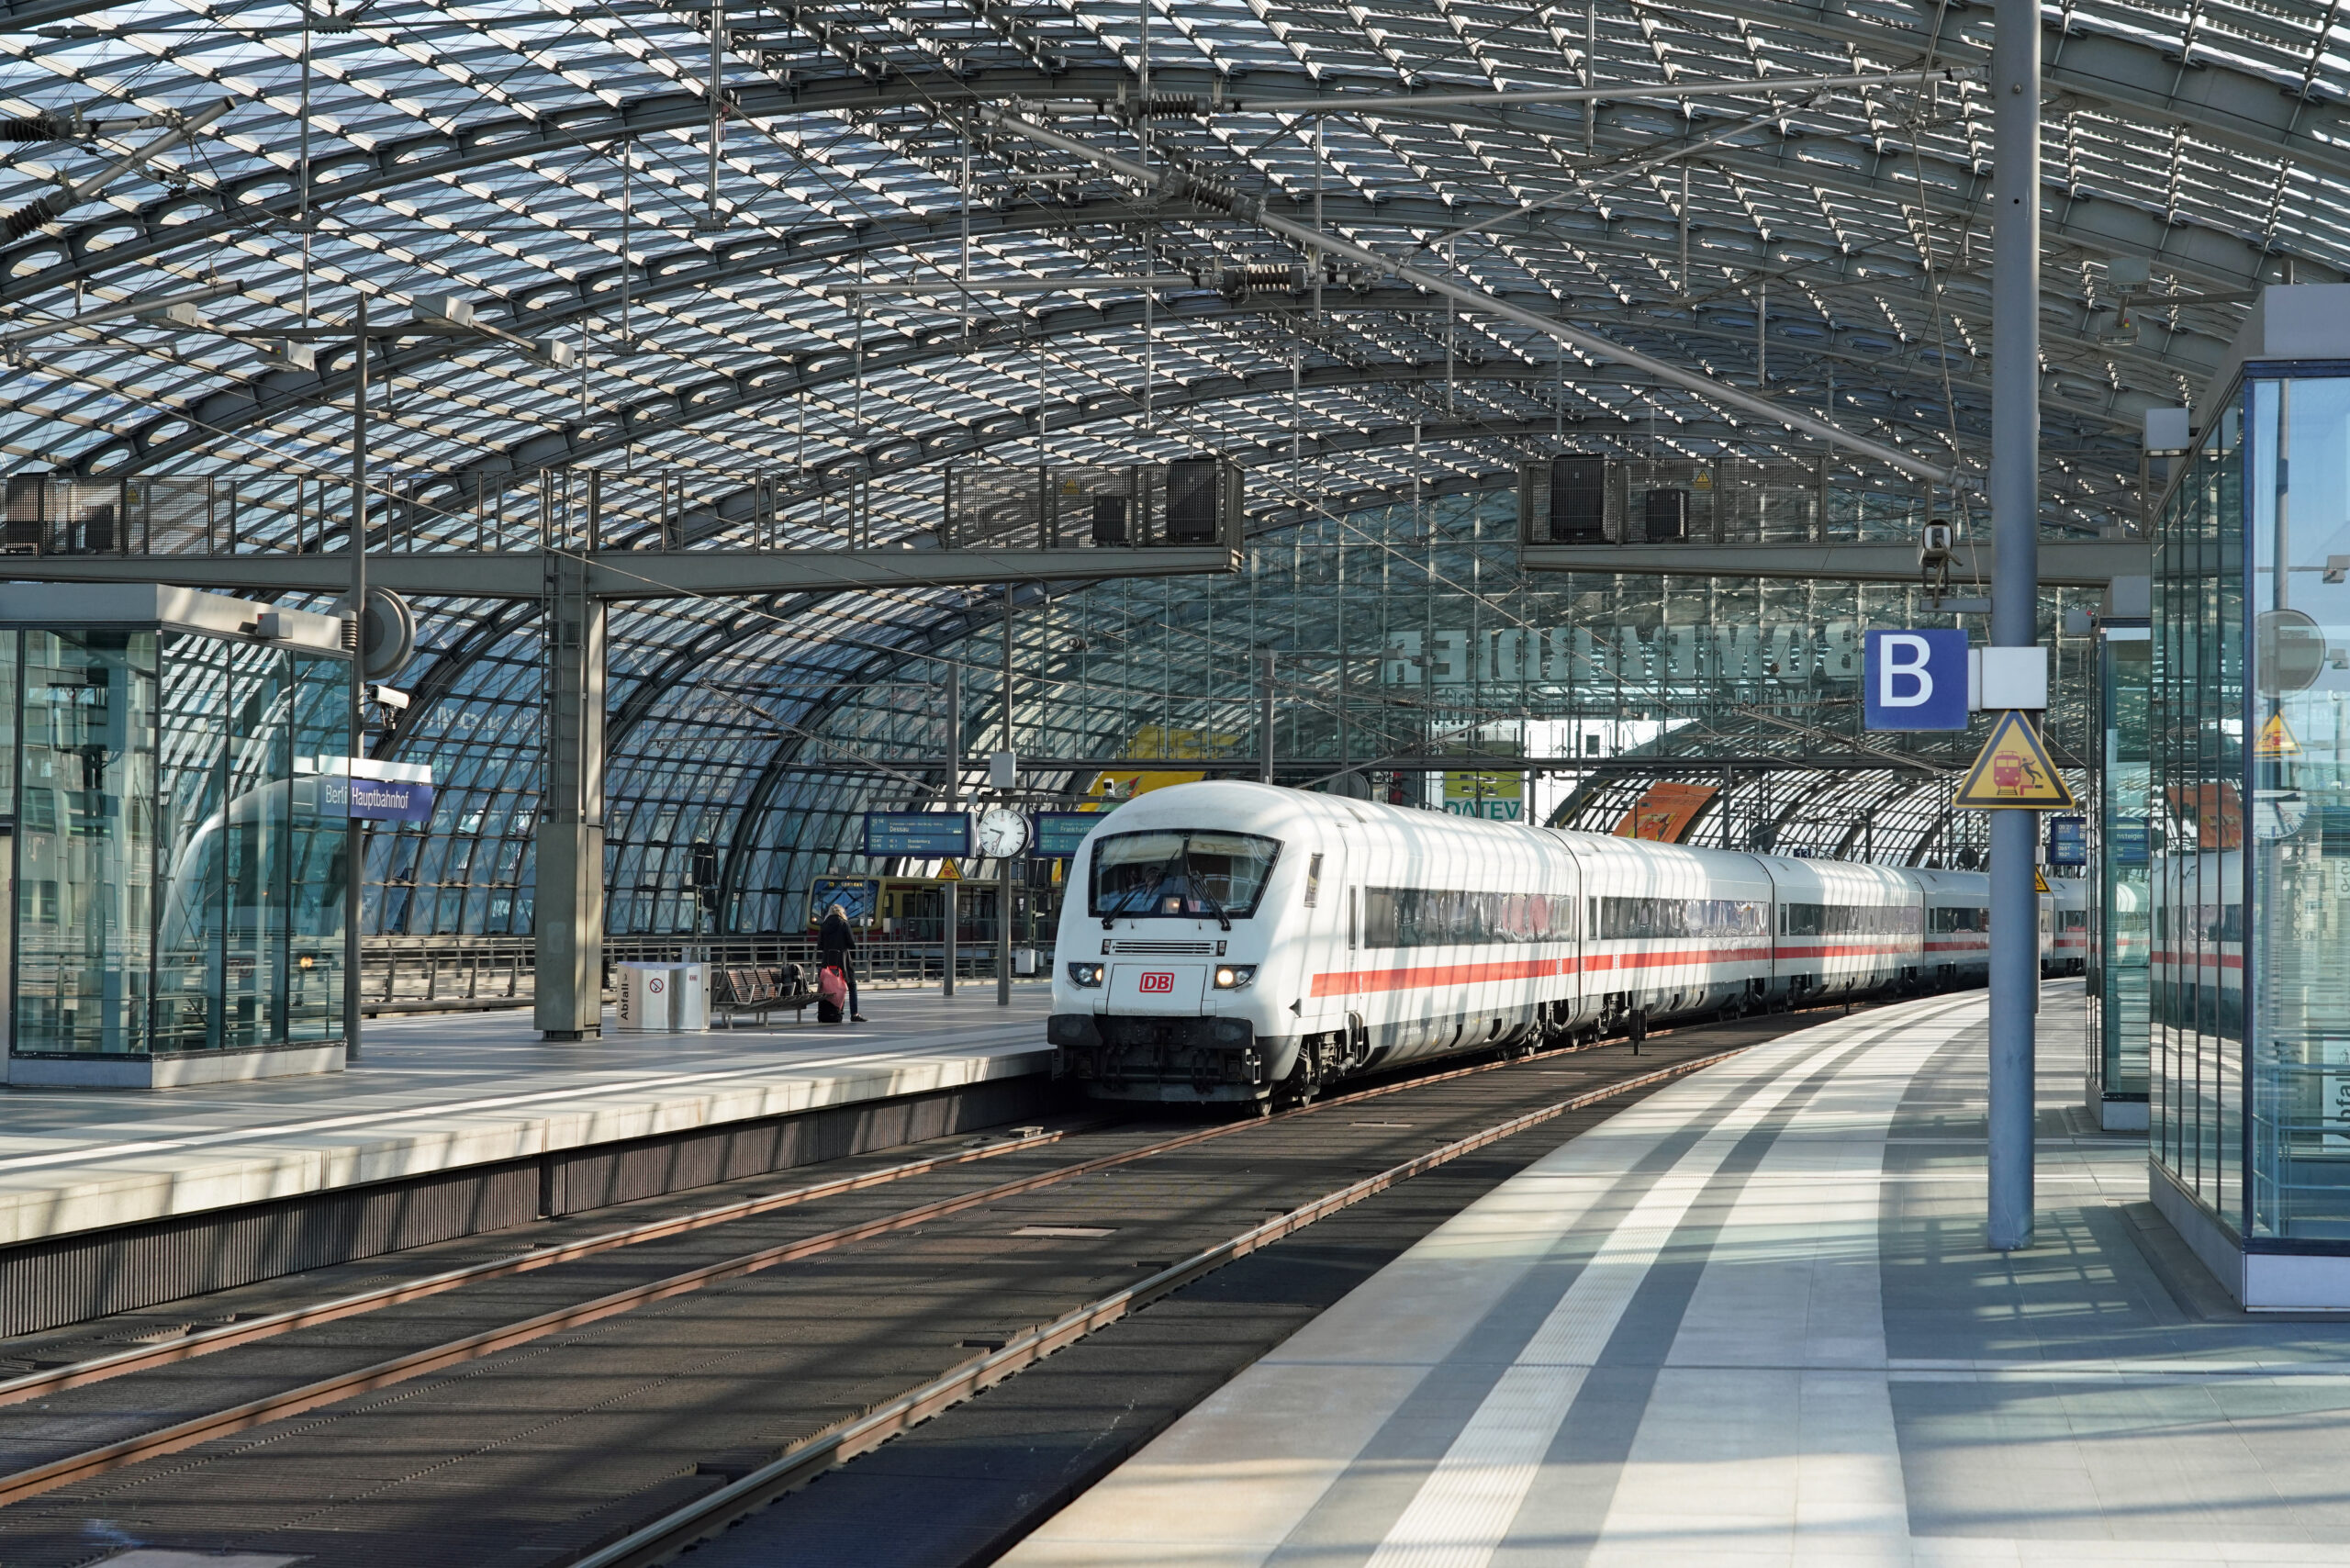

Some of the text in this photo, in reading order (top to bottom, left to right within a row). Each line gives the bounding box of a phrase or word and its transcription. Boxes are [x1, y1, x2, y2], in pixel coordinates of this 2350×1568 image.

[1880, 634, 1933, 707] B
[325, 784, 409, 811] Berli Hauptbahnhof
[1445, 801, 1521, 820] DATEV
[2116, 833, 2144, 841] nsteigen
[1143, 975, 1170, 991] DB
[621, 983, 629, 1021] Abfall
